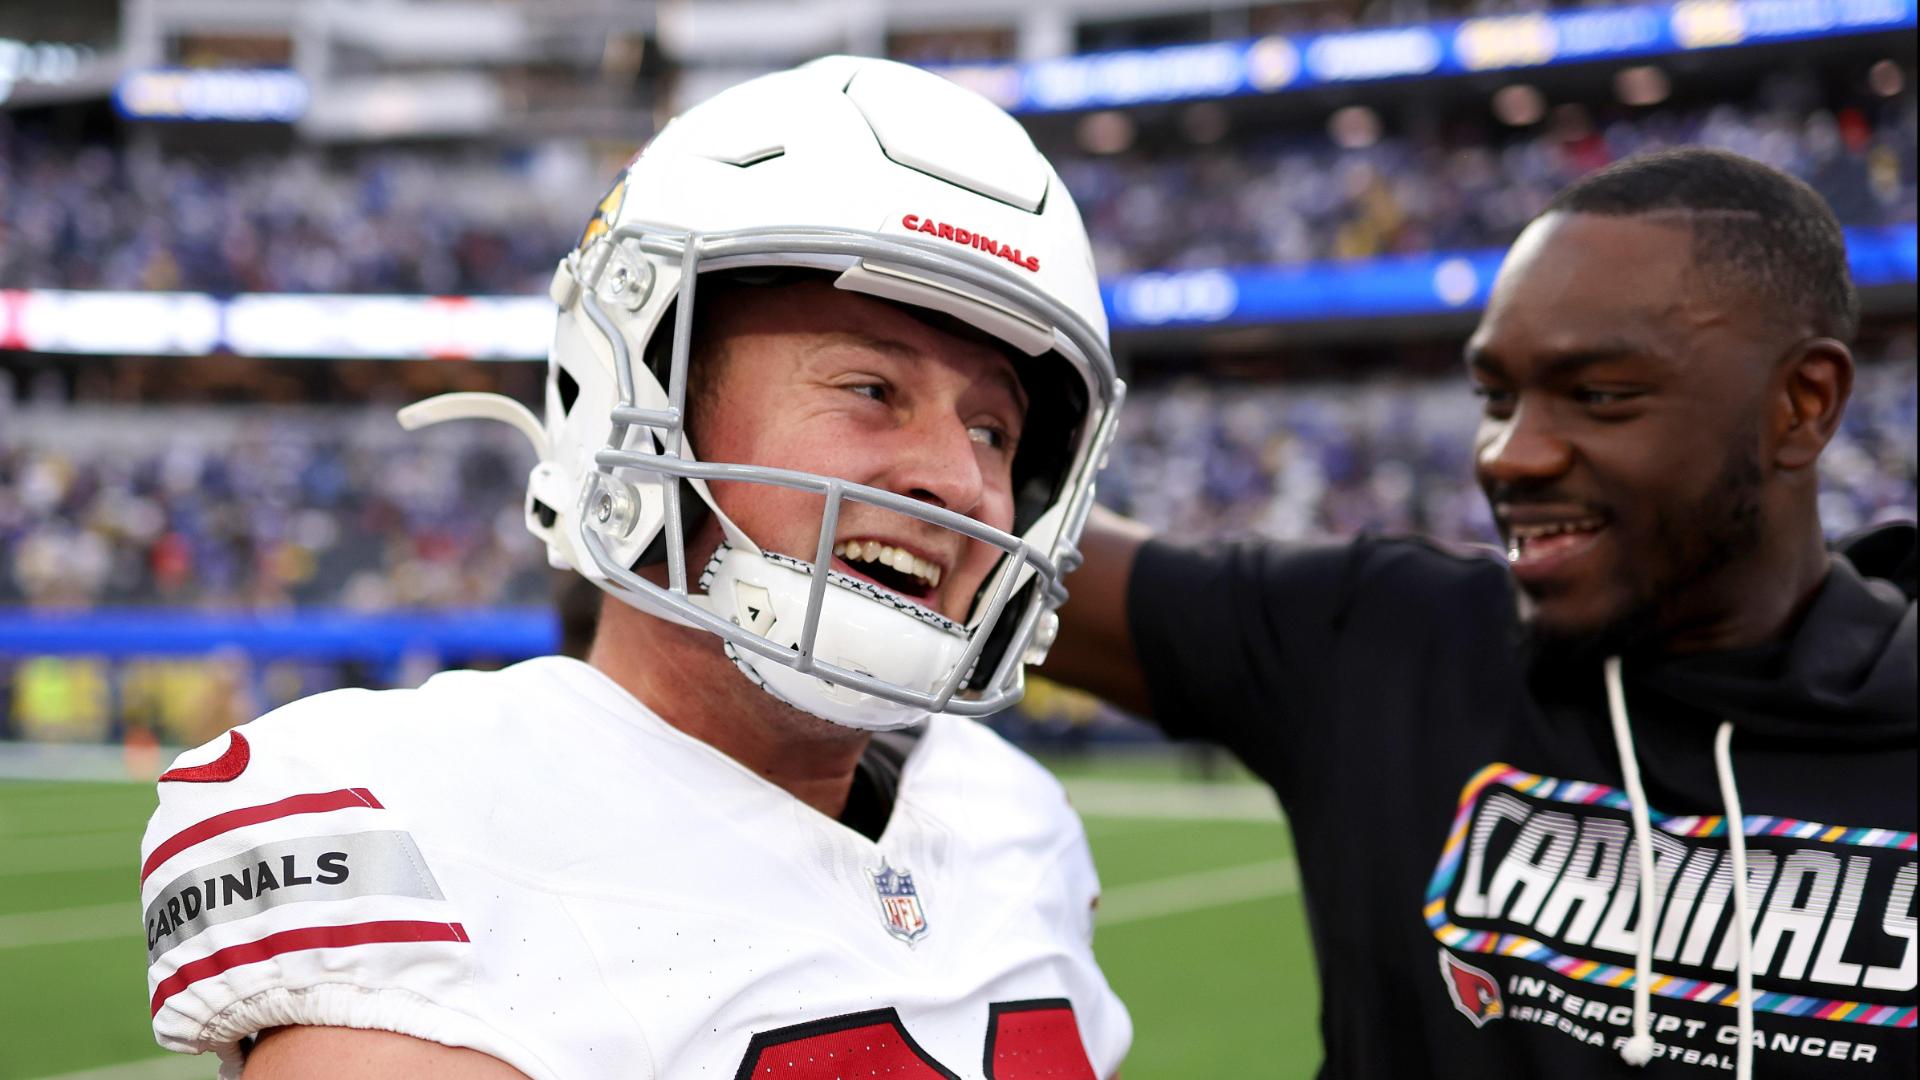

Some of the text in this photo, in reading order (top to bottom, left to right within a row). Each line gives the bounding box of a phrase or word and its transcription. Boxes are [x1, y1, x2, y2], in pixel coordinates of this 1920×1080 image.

[902, 214, 1040, 272] CARDINALS
[147, 851, 350, 952] CARDINALS
[883, 897, 923, 932] NFL
[1455, 792, 1917, 992] CARDINALS
[1508, 975, 1878, 1063] INTERCPT CANCER
